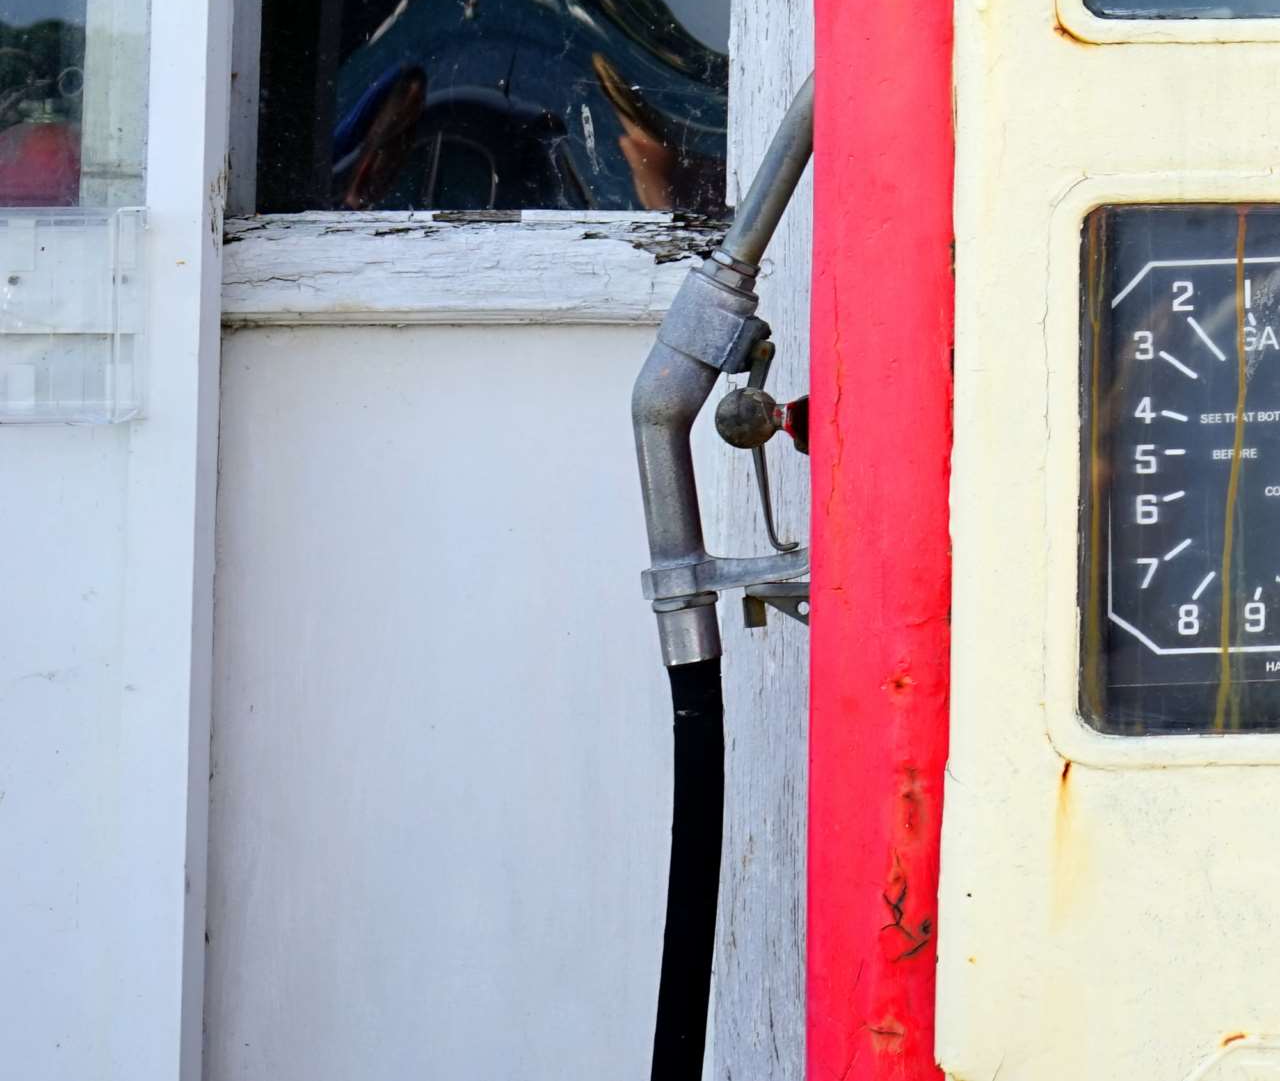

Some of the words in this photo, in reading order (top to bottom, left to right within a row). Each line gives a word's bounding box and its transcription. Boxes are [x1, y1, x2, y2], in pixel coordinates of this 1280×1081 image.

[1172, 281, 1194, 311] 2
[1244, 279, 1251, 309] 1
[1133, 330, 1154, 360] 3
[1134, 396, 1156, 424] 4
[1200, 414, 1222, 424] SEE
[1134, 444, 1157, 474] 5
[1135, 494, 1158, 525] 6
[1136, 558, 1159, 589] 7
[1178, 604, 1200, 635] 8
[1244, 602, 1266, 632] 9
